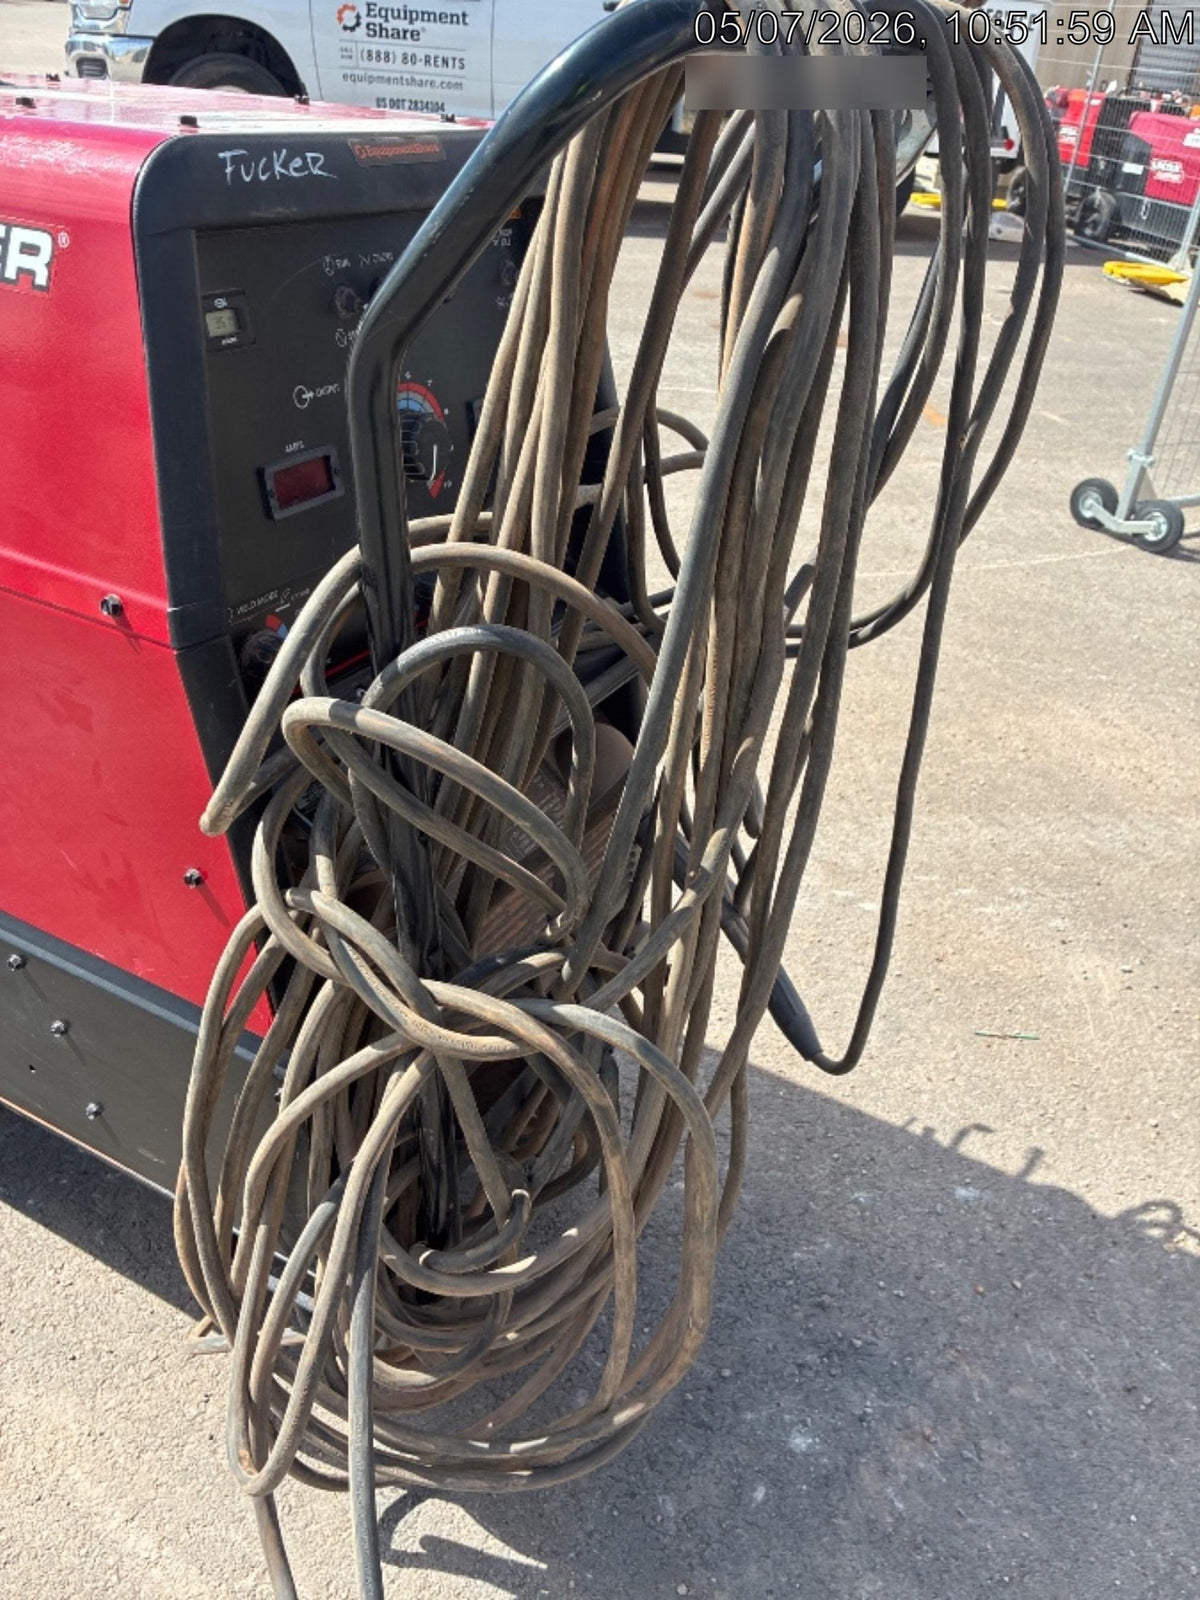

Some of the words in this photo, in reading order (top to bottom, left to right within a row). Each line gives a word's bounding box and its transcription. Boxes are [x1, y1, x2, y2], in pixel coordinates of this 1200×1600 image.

[365, 2, 469, 26] Equipment
[365, 22, 421, 42] Share
[360, 47, 396, 65] (888)
[401, 52, 466, 70] 80-RENTS
[342, 72, 464, 91] equipmentshare.com
[389, 97, 406, 111] DOT
